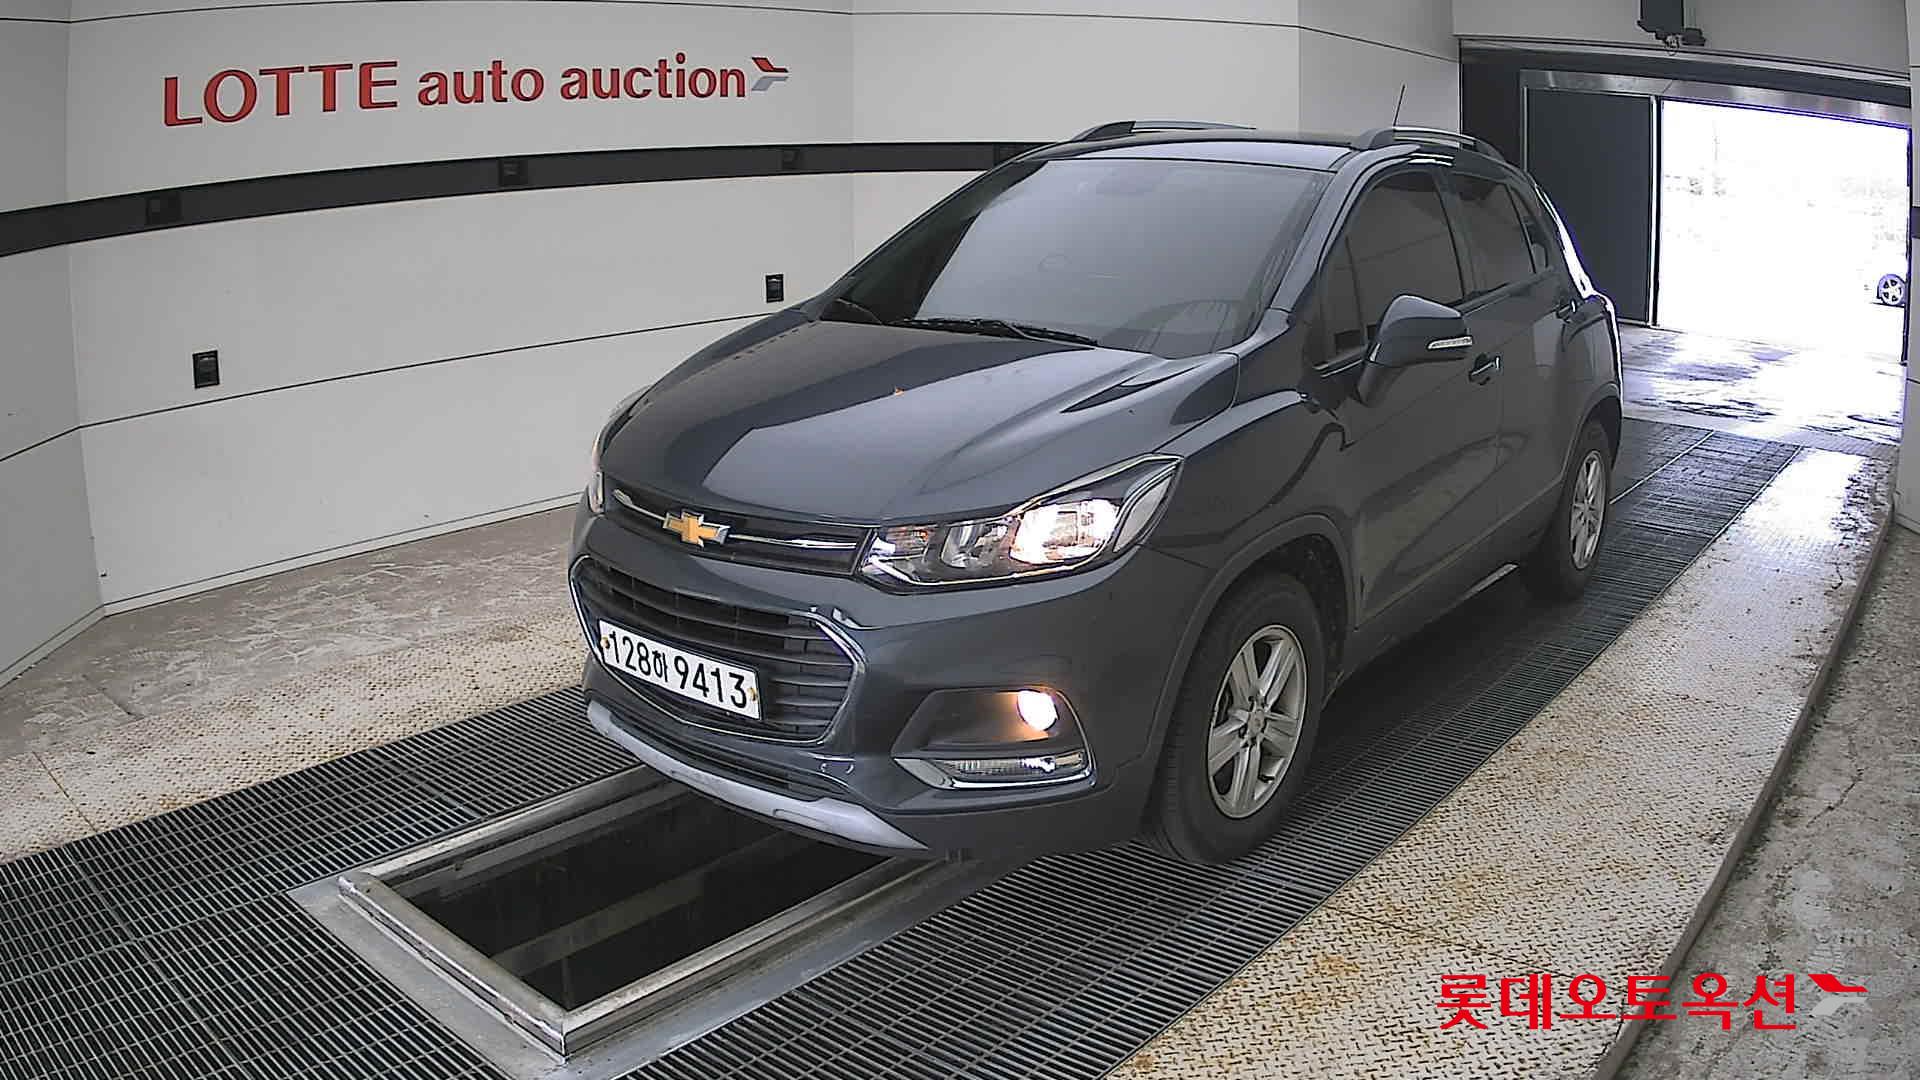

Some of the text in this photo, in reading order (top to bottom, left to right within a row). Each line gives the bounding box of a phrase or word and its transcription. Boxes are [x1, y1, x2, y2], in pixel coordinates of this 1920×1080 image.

[163, 52, 746, 127] LOTTE auto auction
[673, 655, 748, 709] 9413
